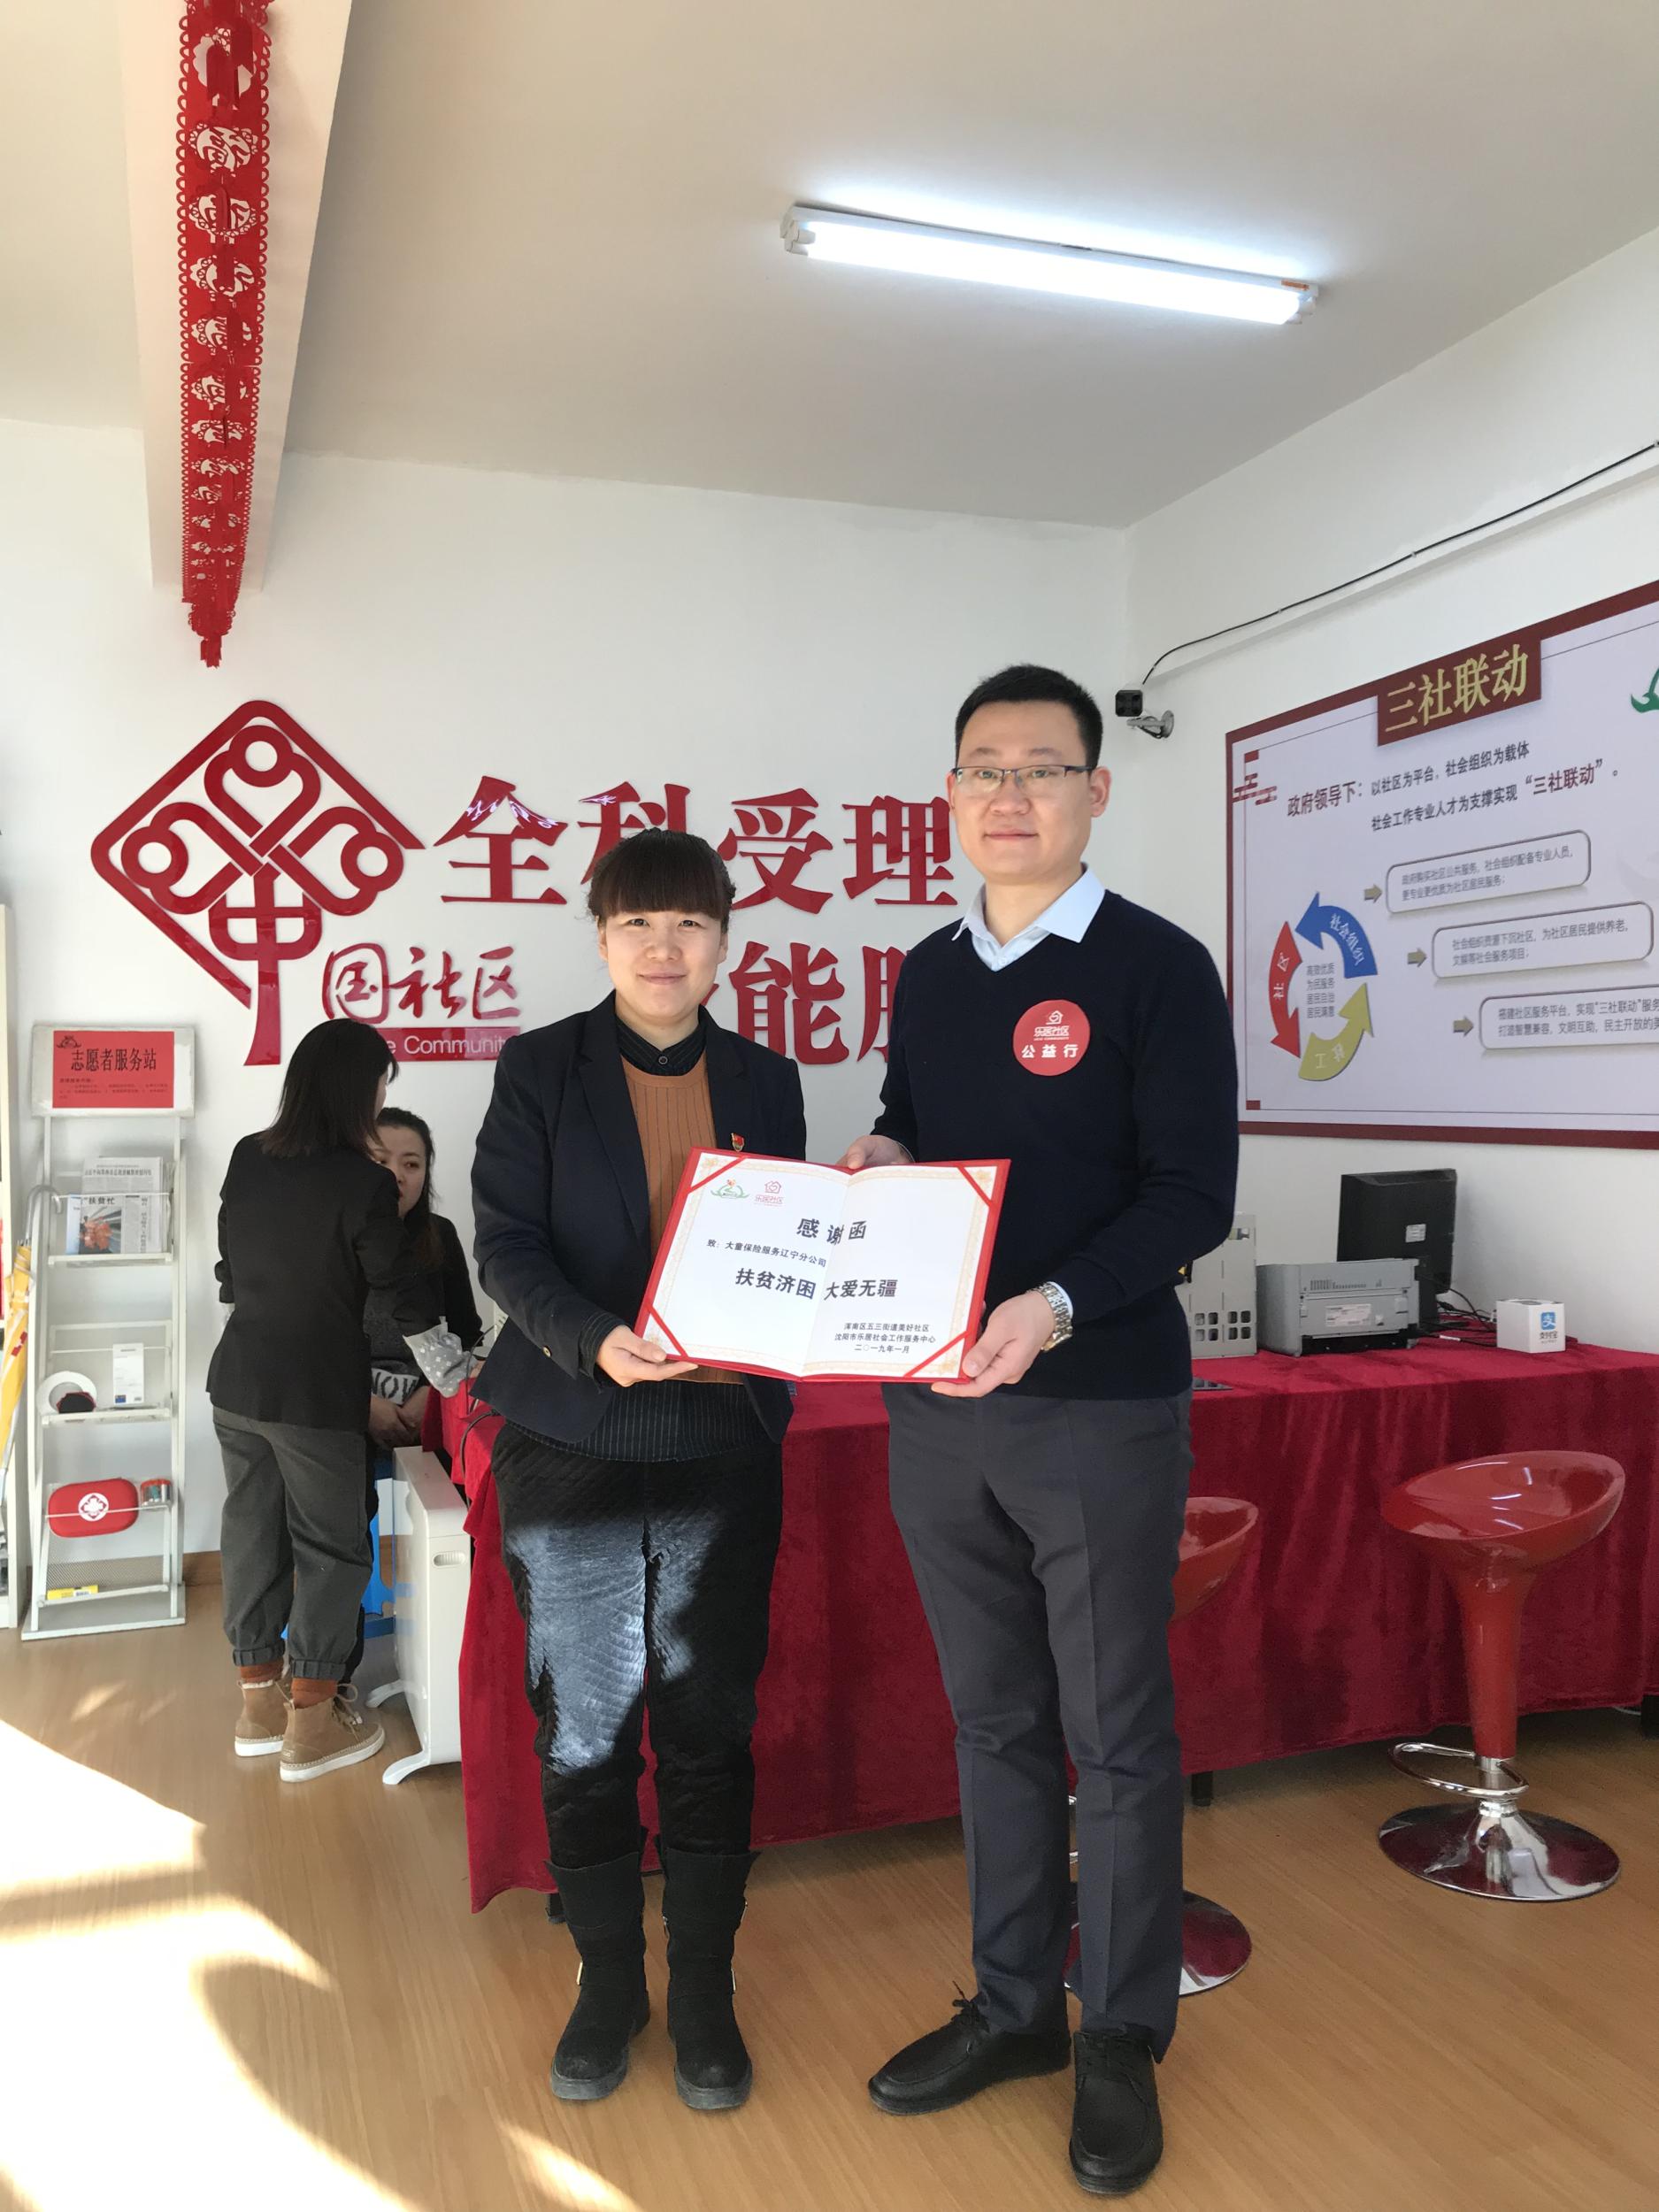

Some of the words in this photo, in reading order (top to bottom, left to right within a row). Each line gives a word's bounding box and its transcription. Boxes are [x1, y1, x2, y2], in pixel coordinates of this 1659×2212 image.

[1385, 644, 1528, 732] 三社联动
[1330, 913, 1364, 965] 社会组织
[404, 1035, 507, 1055] Communit
[1021, 1044, 1079, 1058] 公益行
[71, 1048, 157, 1071] 志愿者服务站
[796, 1217, 867, 1245] 感谢函
[834, 1333, 936, 1343] 沈阳市乐居社会工作服务中心
